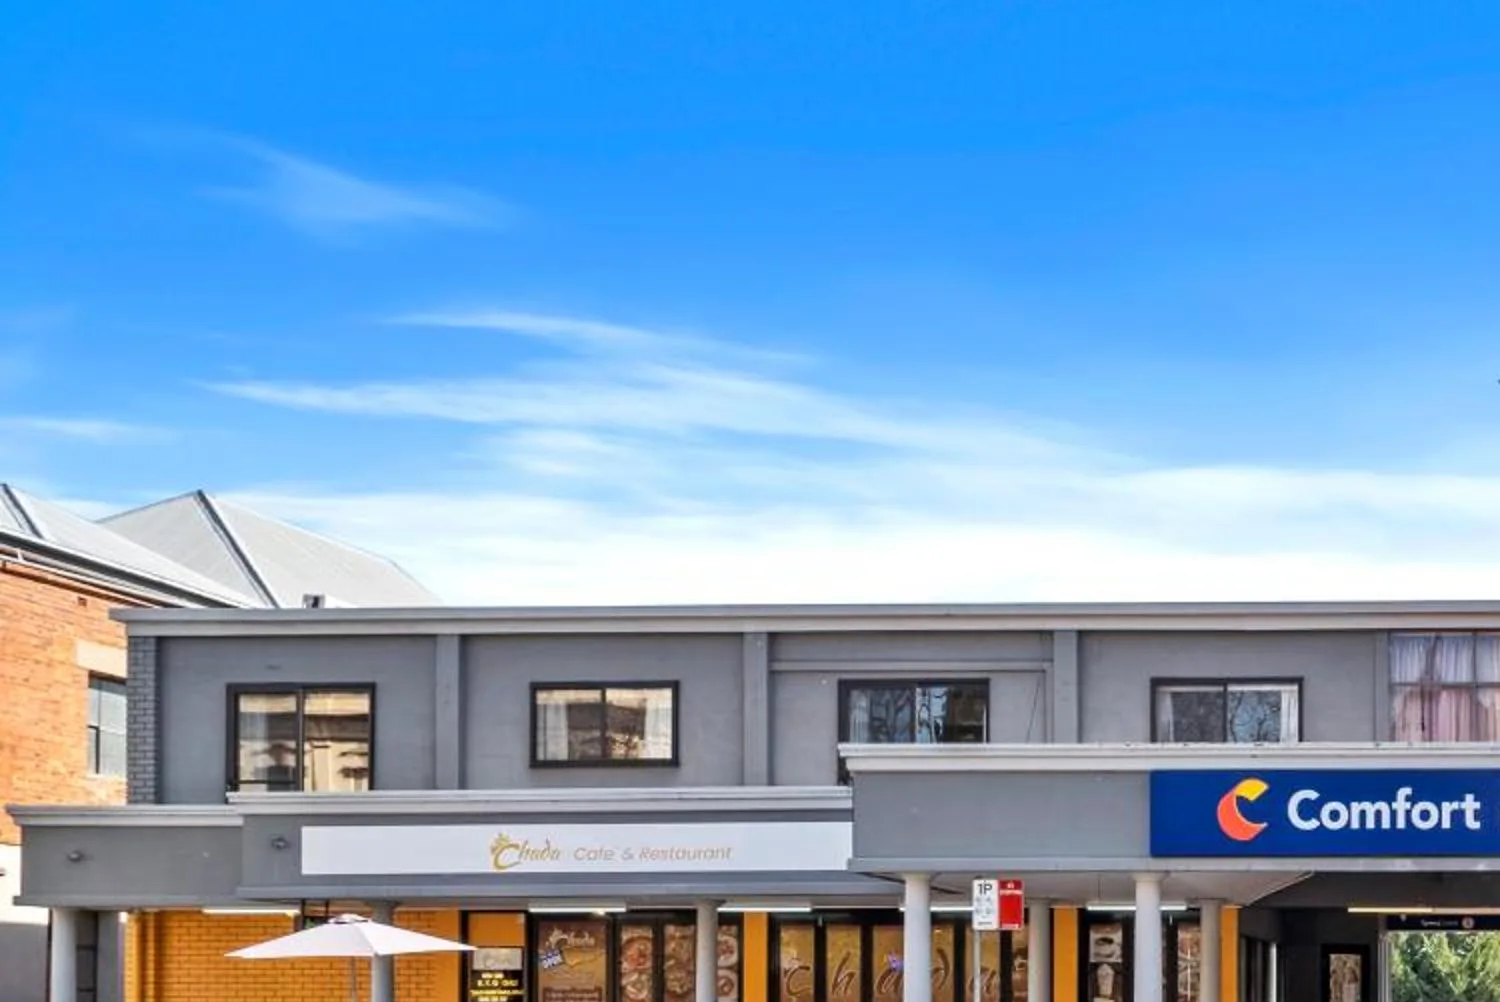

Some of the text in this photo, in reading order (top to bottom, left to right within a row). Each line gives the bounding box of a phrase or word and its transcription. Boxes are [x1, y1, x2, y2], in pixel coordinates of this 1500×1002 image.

[1287, 787, 1481, 830] Comfort
[621, 847, 634, 861] &
[638, 846, 732, 861] Restaurant
[978, 883, 993, 895] 1P
